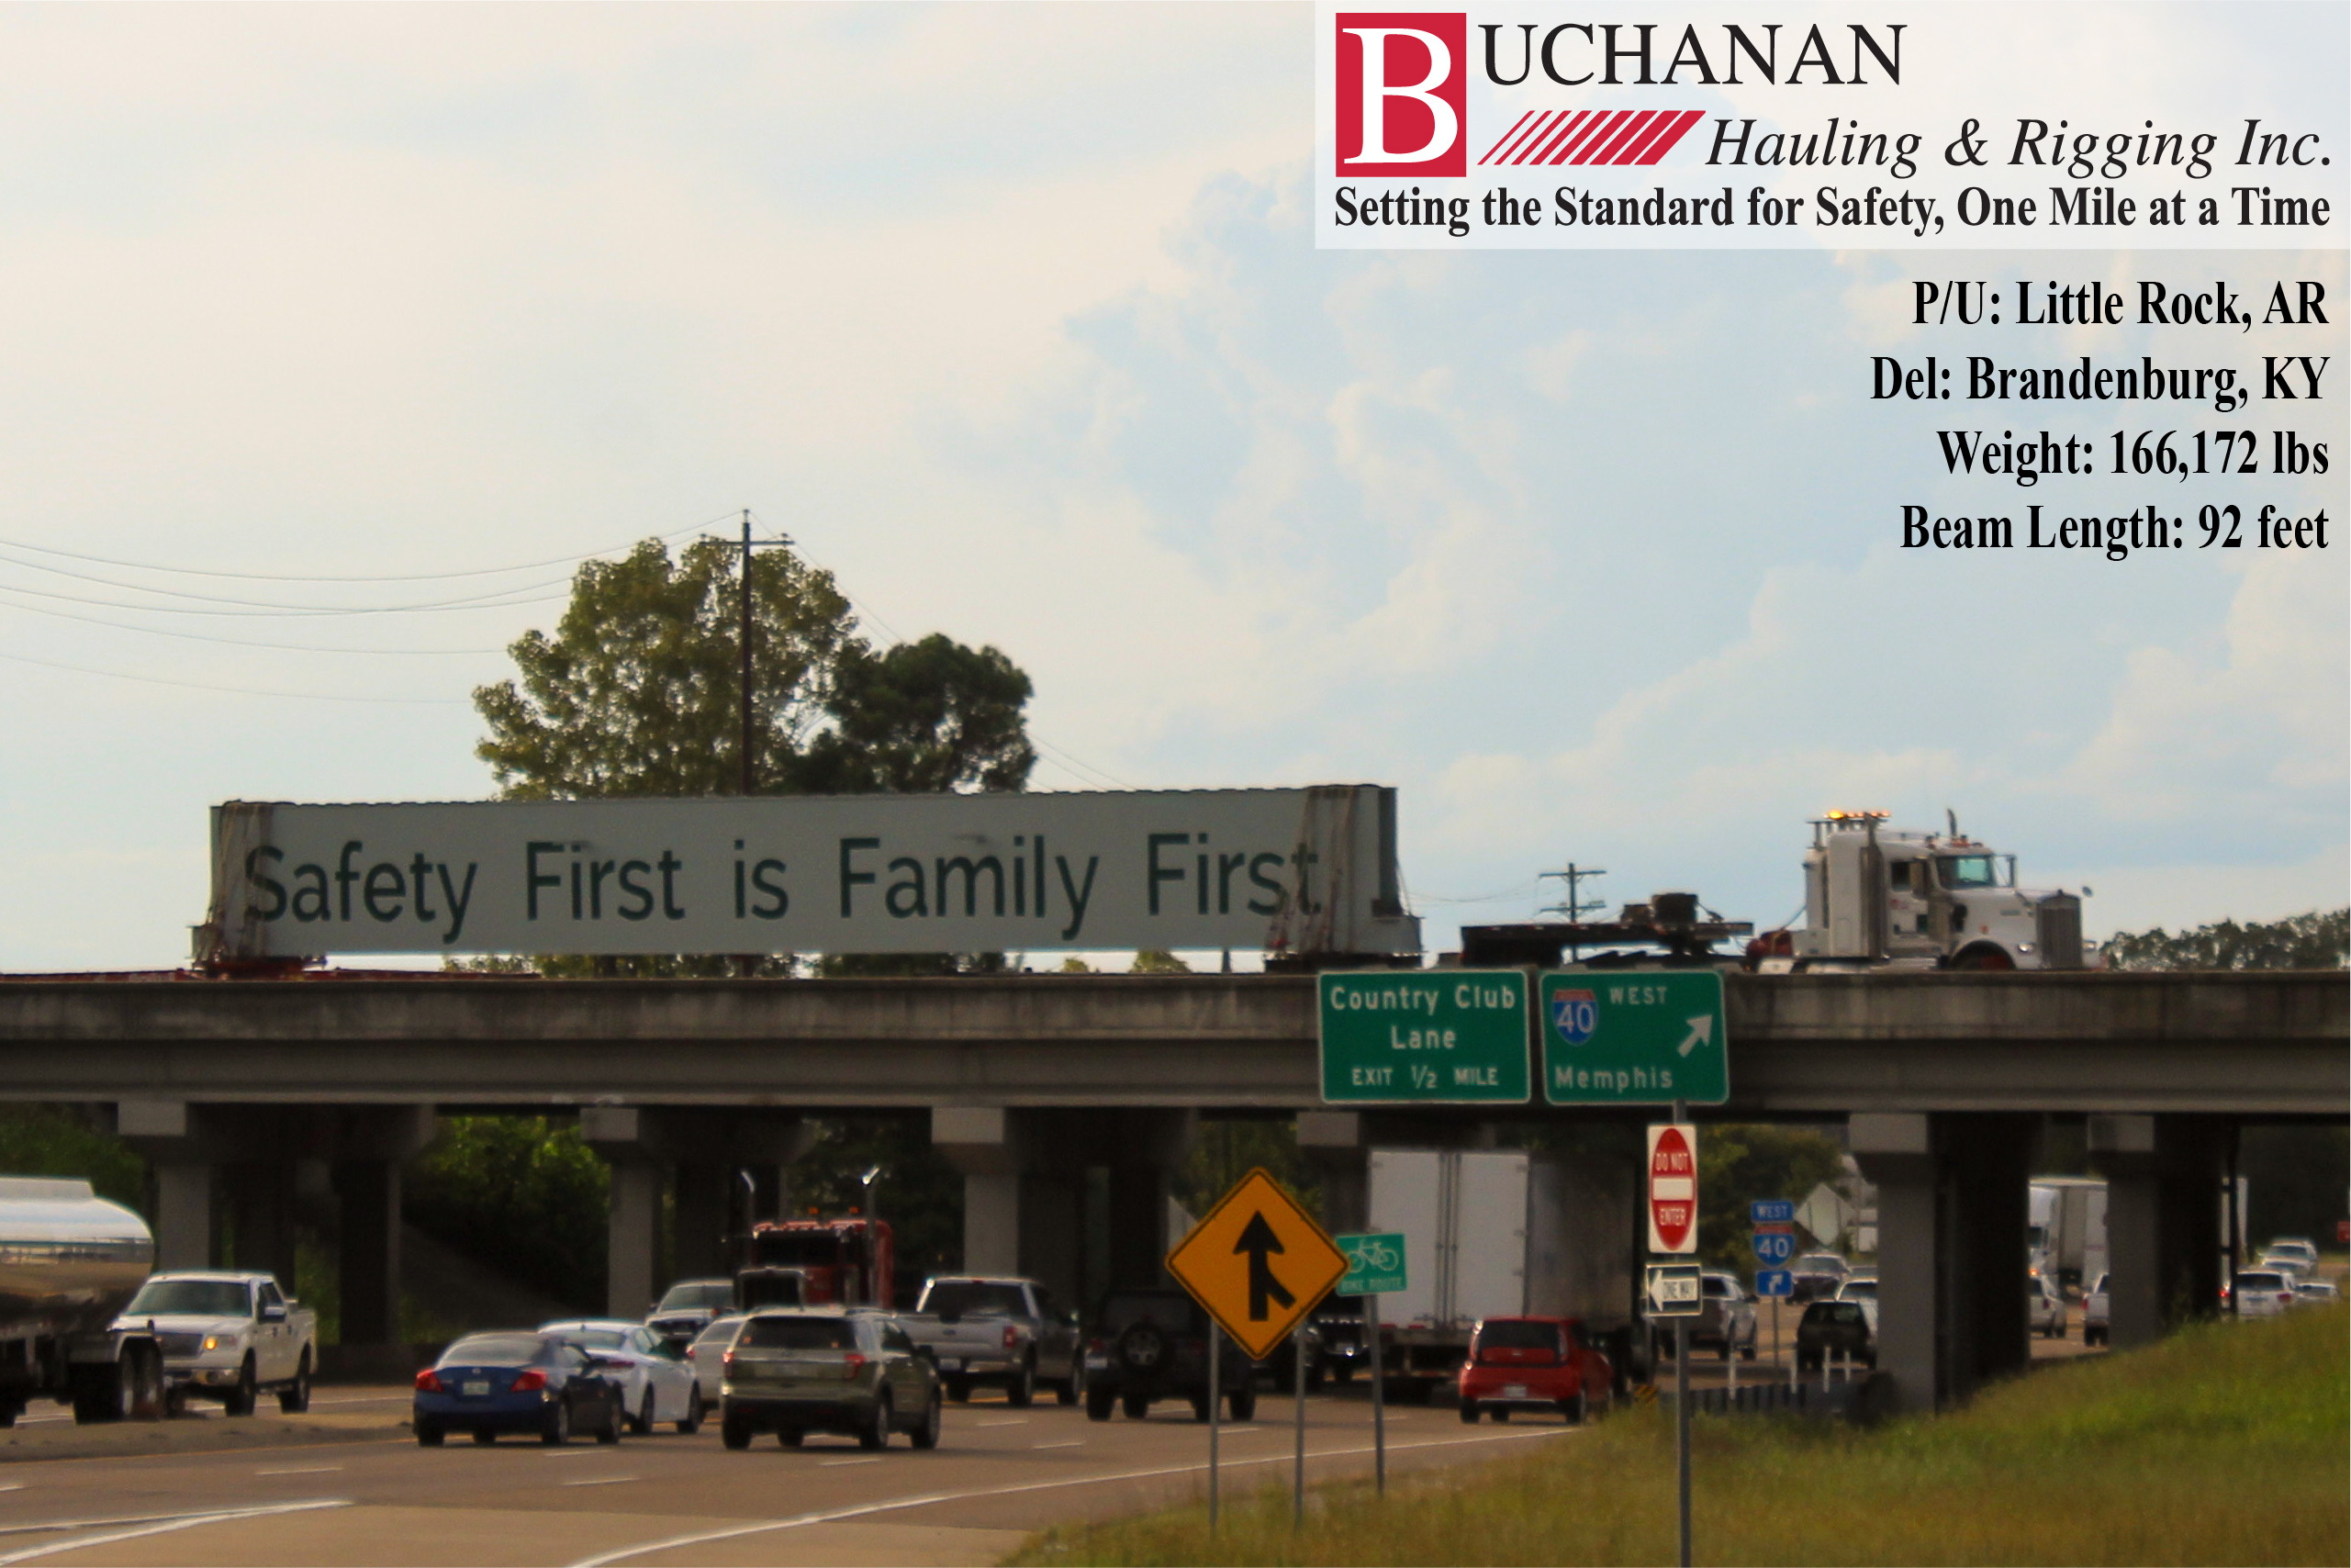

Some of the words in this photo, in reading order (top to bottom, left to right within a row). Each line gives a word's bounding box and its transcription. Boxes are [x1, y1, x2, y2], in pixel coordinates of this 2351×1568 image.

[244, 840, 476, 944] Safety
[526, 840, 686, 921] First
[734, 839, 789, 920] is
[839, 834, 1099, 940] Family
[1148, 833, 1321, 916] First
[1330, 986, 1439, 1015] Country
[1455, 985, 1516, 1009] Club
[1609, 987, 1667, 1005] WEST
[1556, 1003, 1595, 1034] 40
[1391, 1025, 1456, 1049] Lane
[1352, 1069, 1393, 1085] EXIT
[1454, 1068, 1498, 1086] MILE
[1555, 1066, 1673, 1093] Memphis
[1655, 1152, 1669, 1171] DO
[1671, 1152, 1688, 1171] NOT
[1660, 1207, 1686, 1226] ENTER
[1757, 1205, 1787, 1218] WEST
[1758, 1238, 1788, 1258] 40
